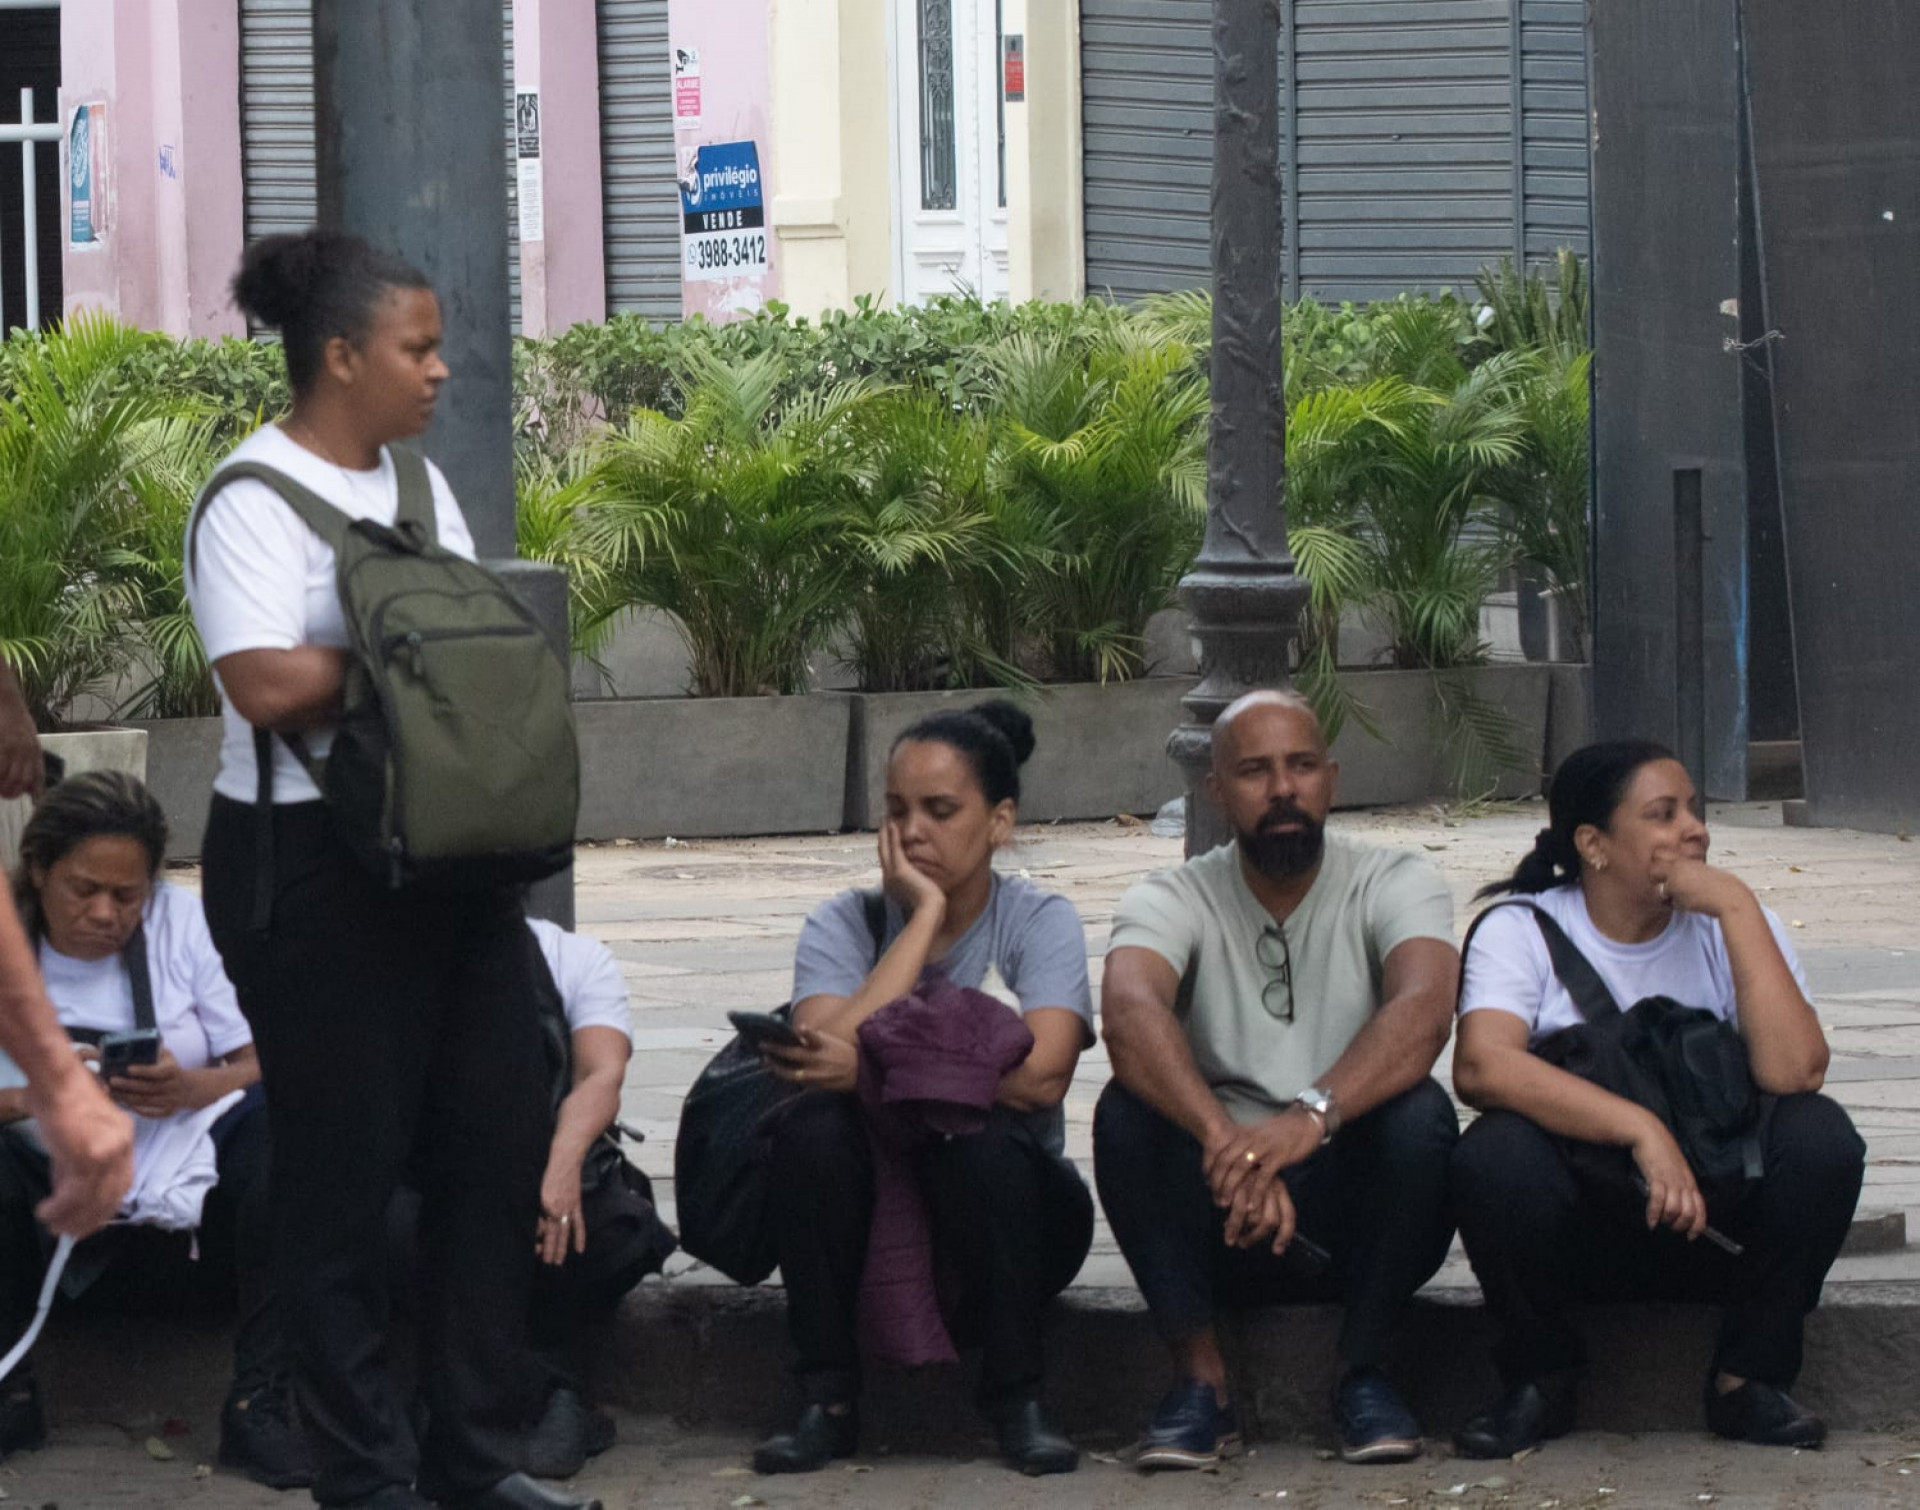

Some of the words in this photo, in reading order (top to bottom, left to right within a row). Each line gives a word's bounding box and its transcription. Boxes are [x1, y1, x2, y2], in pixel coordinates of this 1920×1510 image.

[703, 164, 757, 190] privilégio
[702, 210, 743, 230] VENDE
[698, 235, 766, 269] 3988-3412
